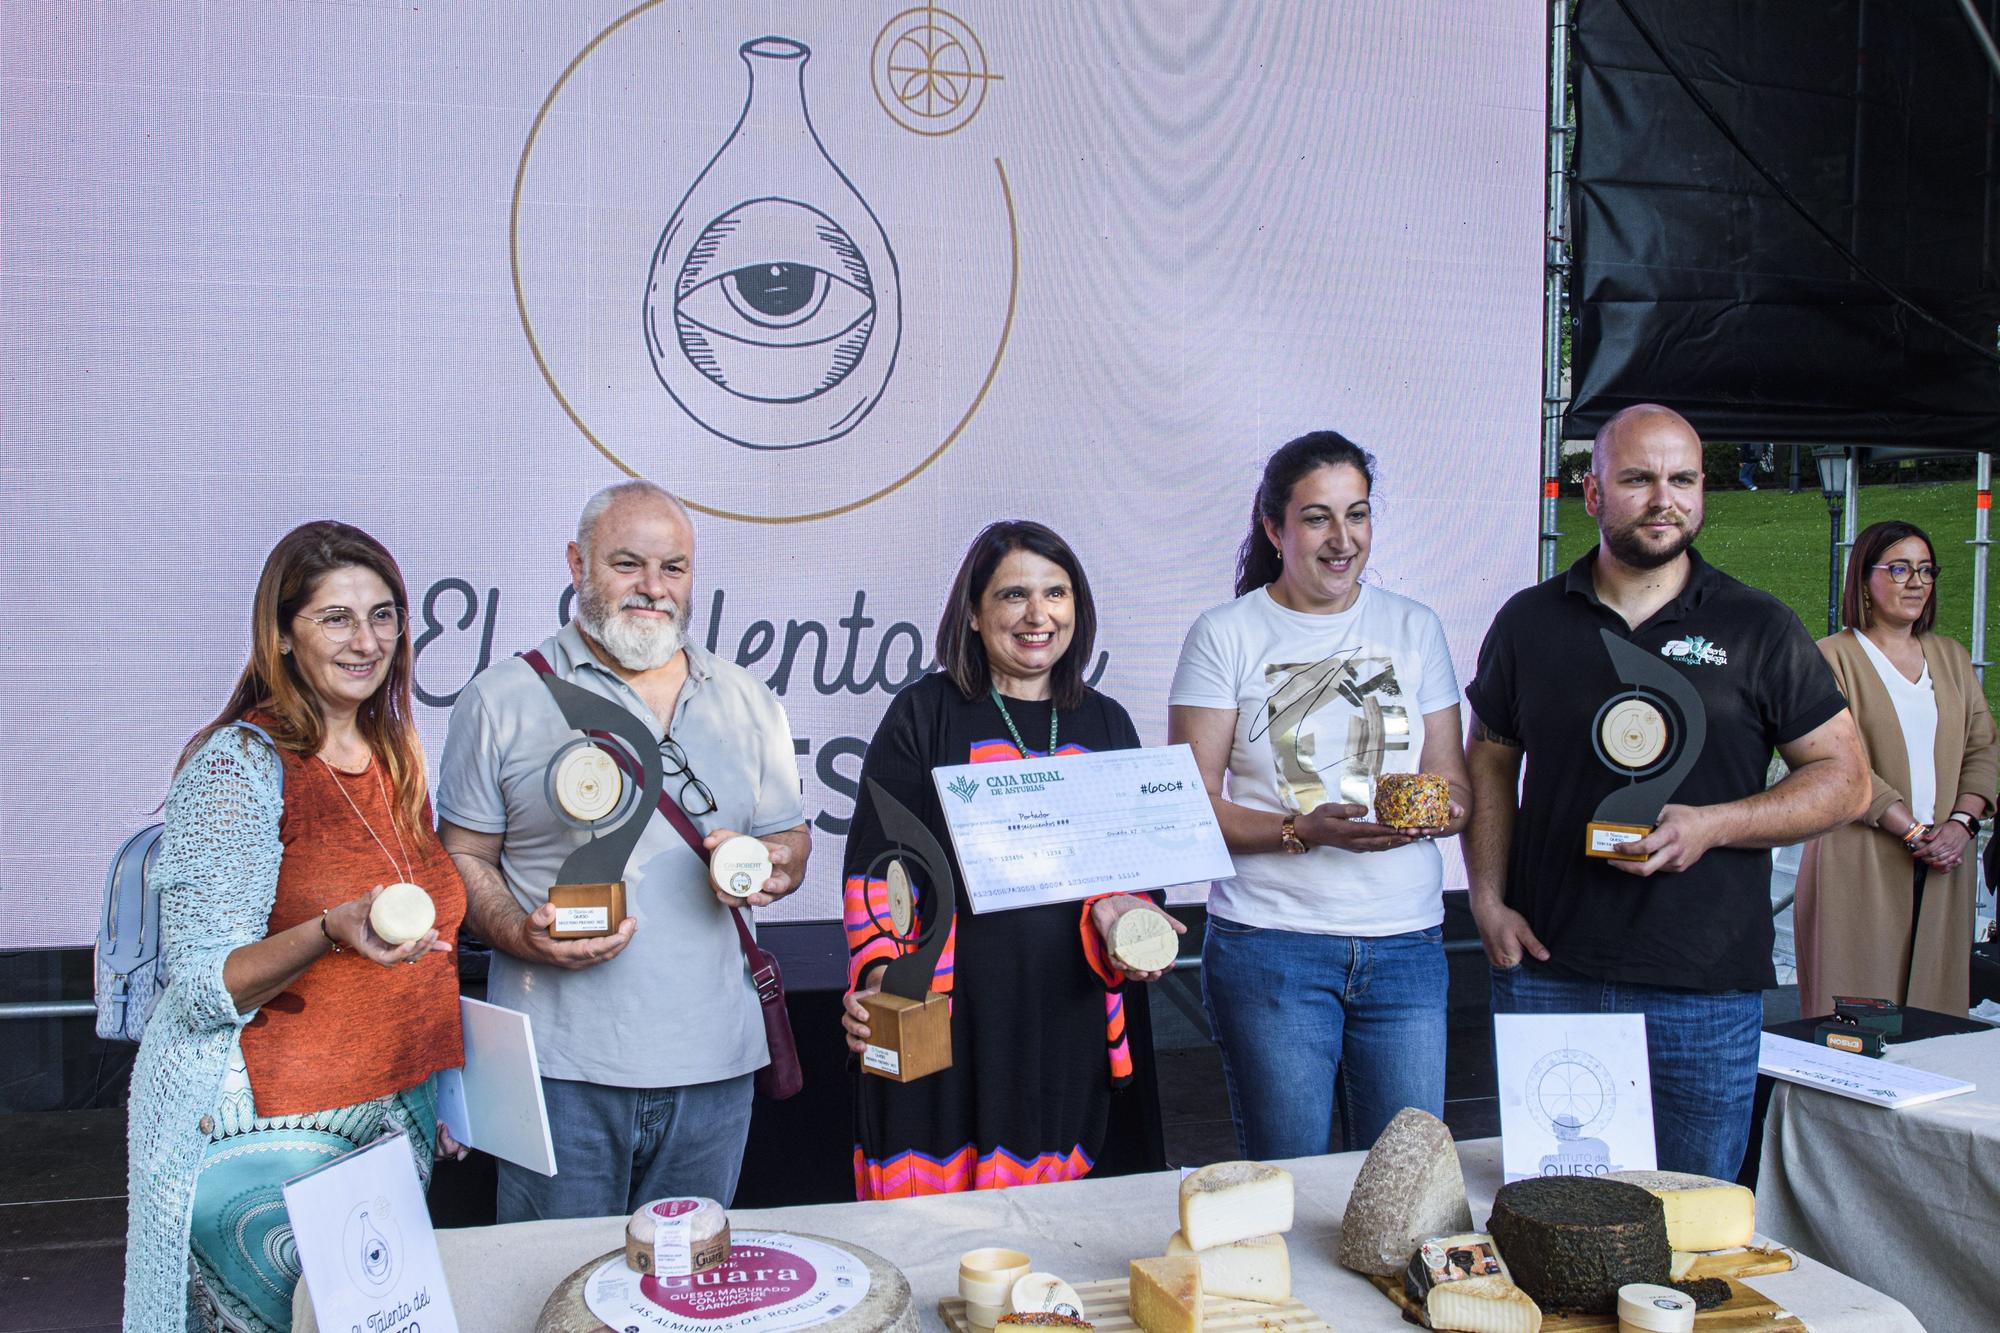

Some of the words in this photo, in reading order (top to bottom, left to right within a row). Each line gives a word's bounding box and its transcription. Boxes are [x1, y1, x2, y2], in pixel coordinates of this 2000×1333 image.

[413, 577, 500, 707] El
[986, 772, 1018, 788] CAJA
[1022, 770, 1065, 785] RURAL
[991, 788, 1003, 796] DE
[1005, 784, 1045, 795] ASTURIAS
[1140, 780, 1183, 794] #600#
[1019, 810, 1050, 822] Portador
[1542, 1153, 1592, 1163] INSTITUTO
[367, 1301, 412, 1333] Talento
[413, 1286, 431, 1311] del
[696, 1297, 763, 1311] GARNACHA
[654, 1318, 733, 1333] ALMUNIAS
